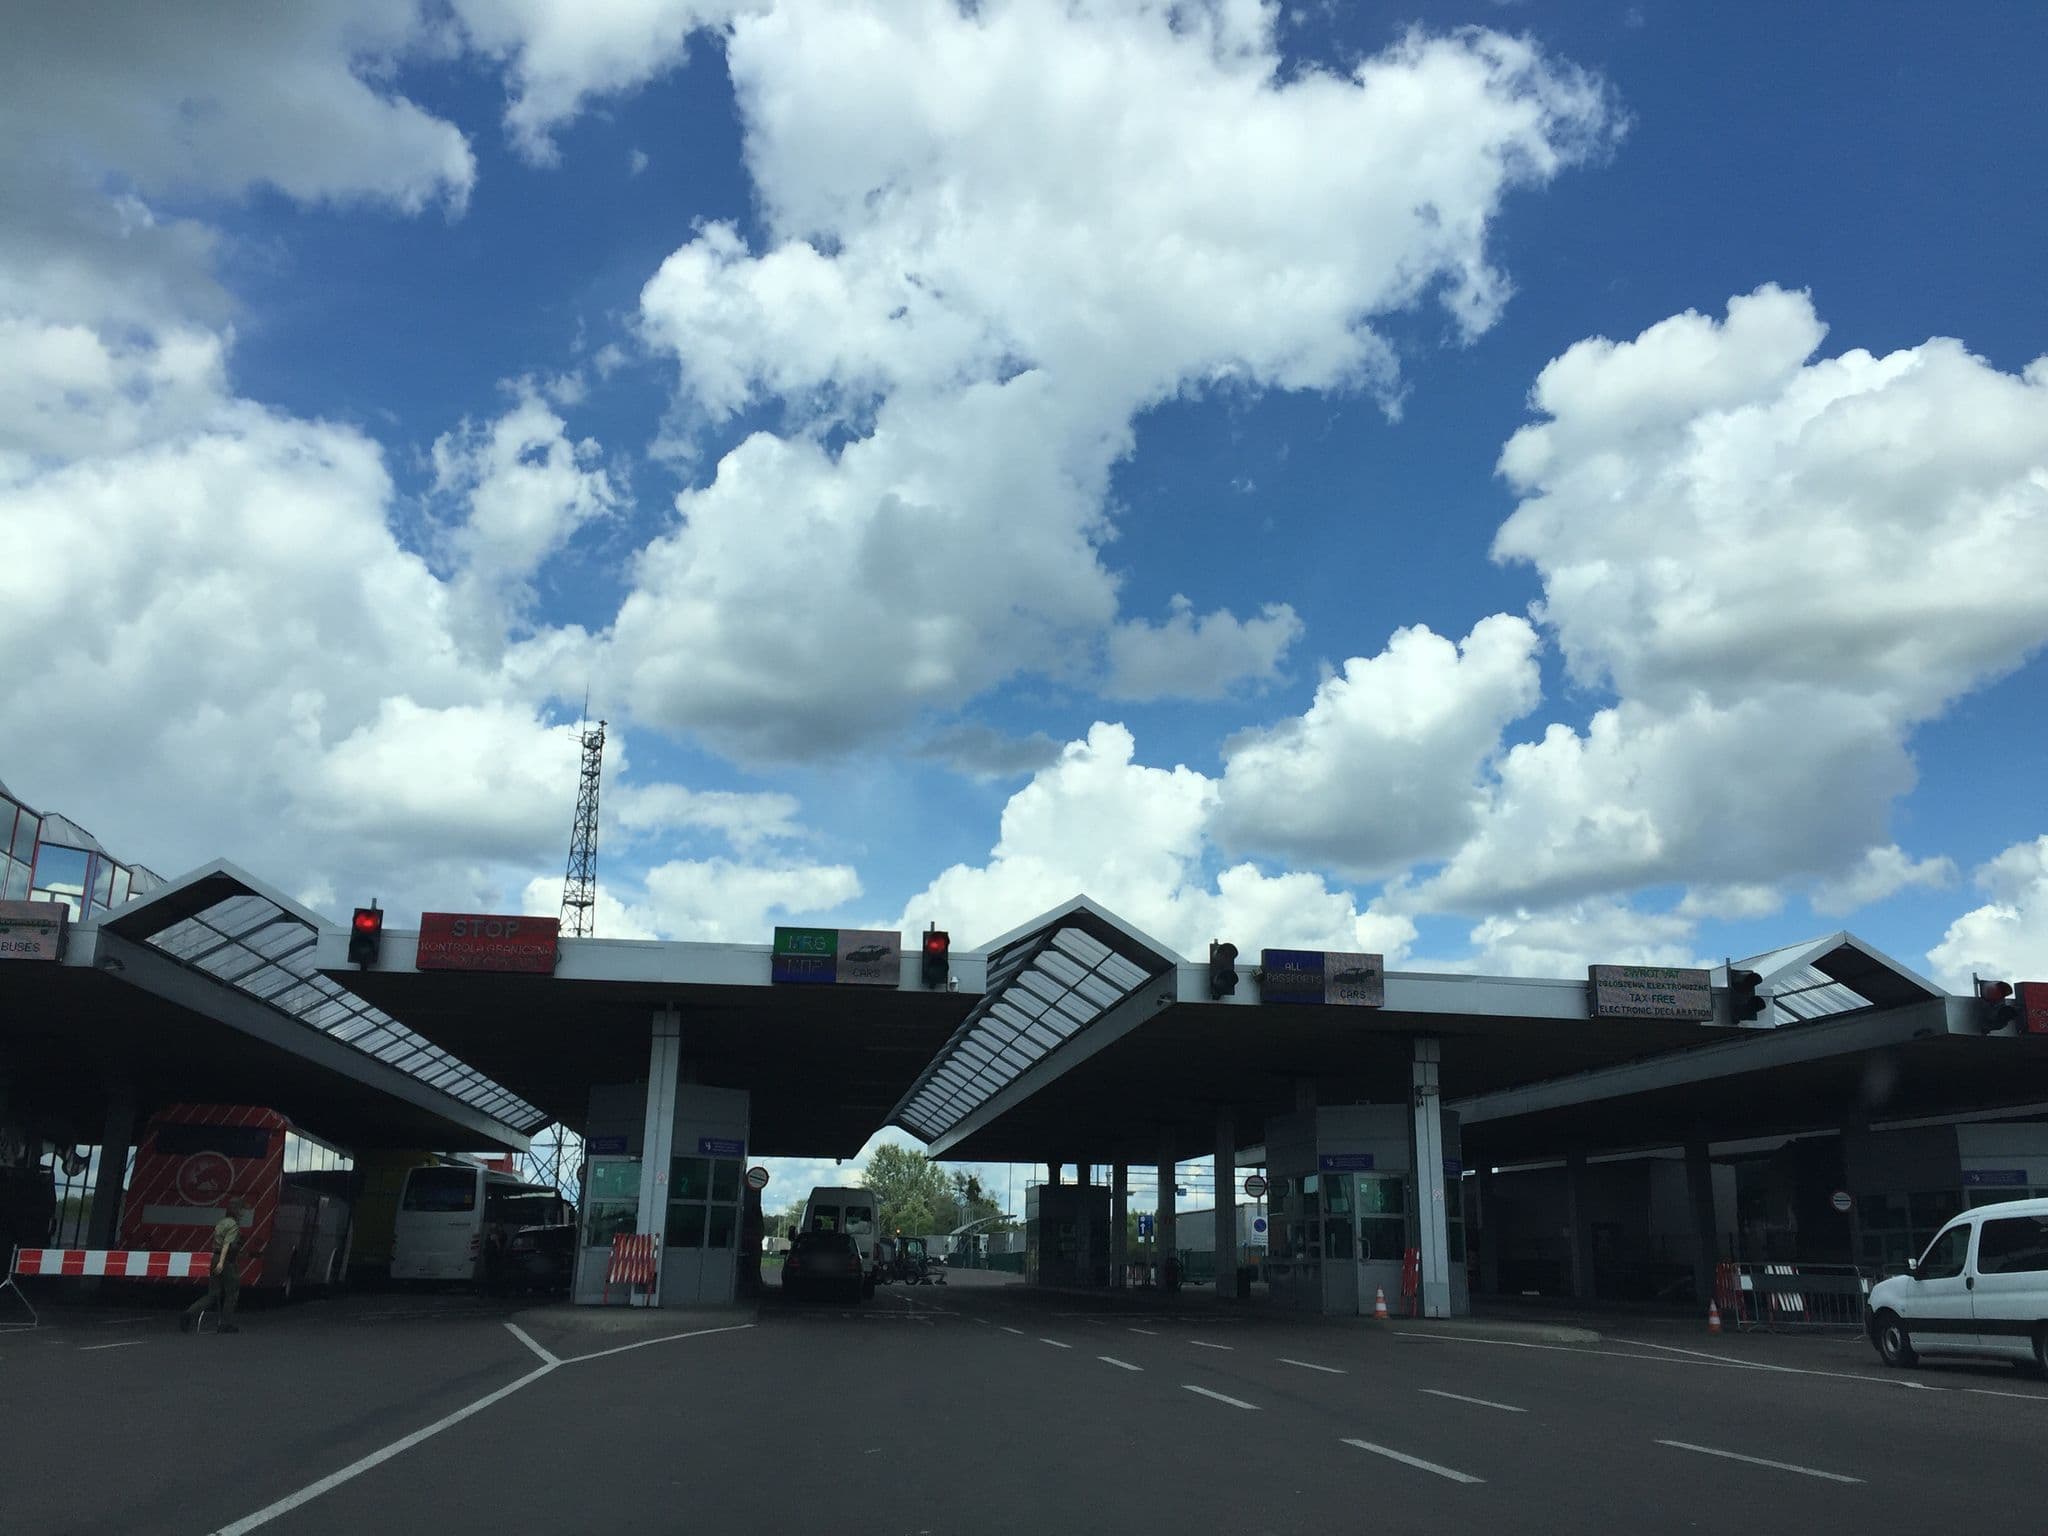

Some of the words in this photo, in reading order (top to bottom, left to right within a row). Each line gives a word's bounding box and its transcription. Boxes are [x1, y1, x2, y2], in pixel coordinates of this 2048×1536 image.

[452, 919, 520, 938] STOP
[0, 941, 41, 953] BUSES
[420, 942, 484, 953] KONTROLA
[486, 943, 552, 955] GRANICZNA
[852, 967, 881, 977] CARS
[1284, 961, 1302, 971] ALL
[1663, 969, 1681, 980] VAT
[1339, 988, 1367, 1000] CARS
[1630, 993, 1649, 1003] TAX
[1651, 994, 1676, 1005] FREE
[1599, 1005, 1654, 1015] ELECTRONIC
[1655, 1008, 1712, 1017] DECLARATION
